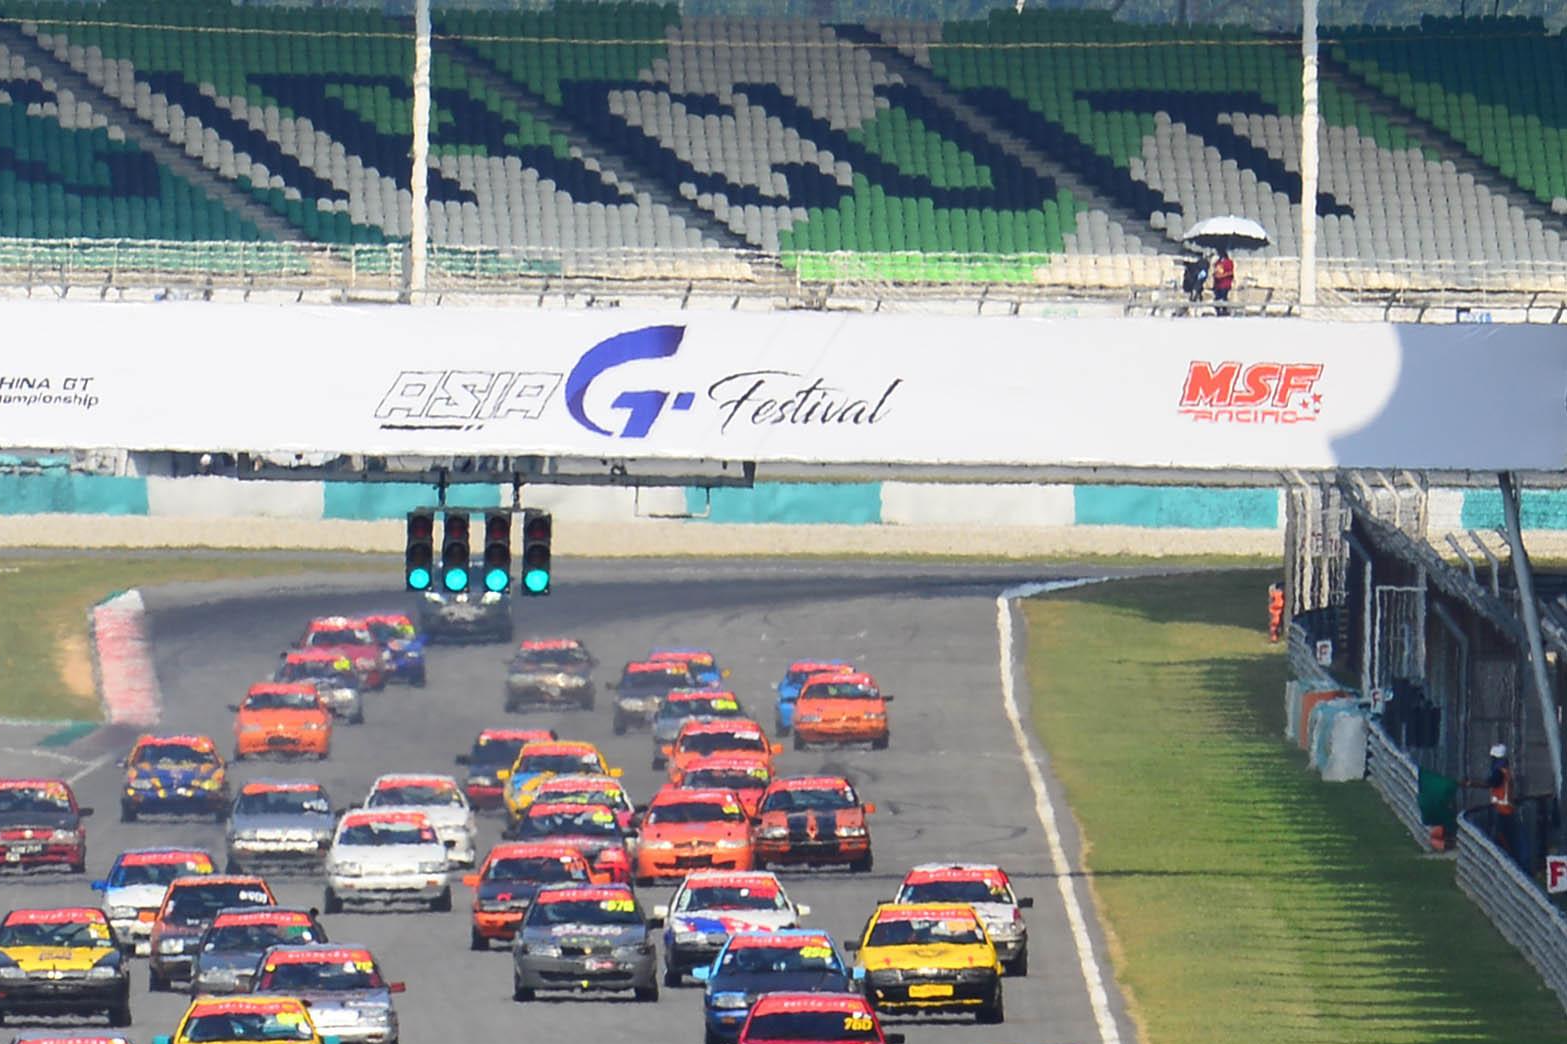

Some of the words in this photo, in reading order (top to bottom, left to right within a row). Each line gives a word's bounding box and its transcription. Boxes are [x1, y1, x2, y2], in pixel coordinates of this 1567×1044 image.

[63, 377, 93, 390] GT
[374, 370, 564, 420] ASIA
[707, 369, 903, 435] Festival
[1179, 360, 1324, 408] MSF
